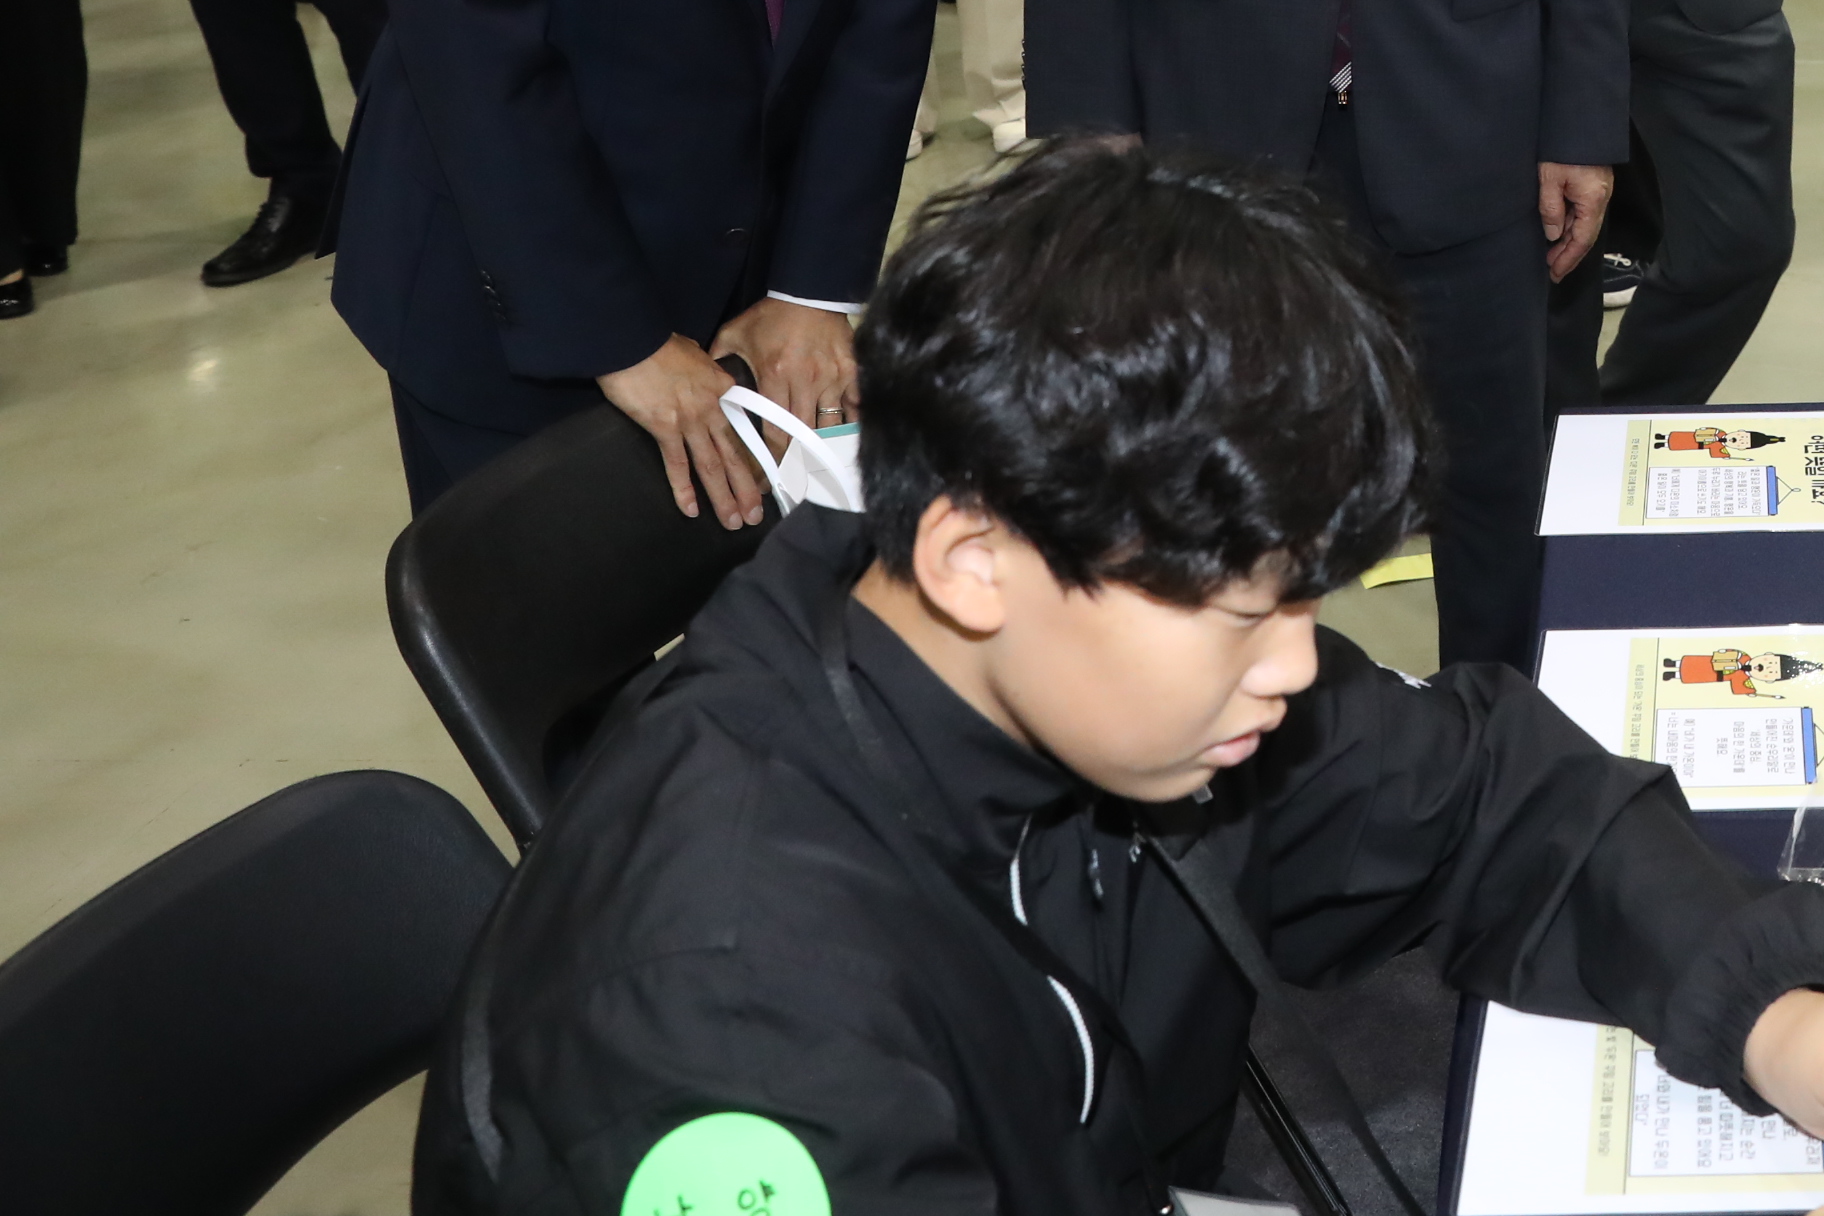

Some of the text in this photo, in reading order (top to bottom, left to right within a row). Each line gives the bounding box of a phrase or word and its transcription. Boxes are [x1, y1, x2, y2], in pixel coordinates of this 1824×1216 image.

[1733, 722, 1745, 738] 마음의
[1766, 719, 1779, 772] 만들어진 순우리말로
[1784, 762, 1795, 774] 만나
[1655, 1118, 1669, 1137] 만나
[1762, 1120, 1776, 1139] 만나
